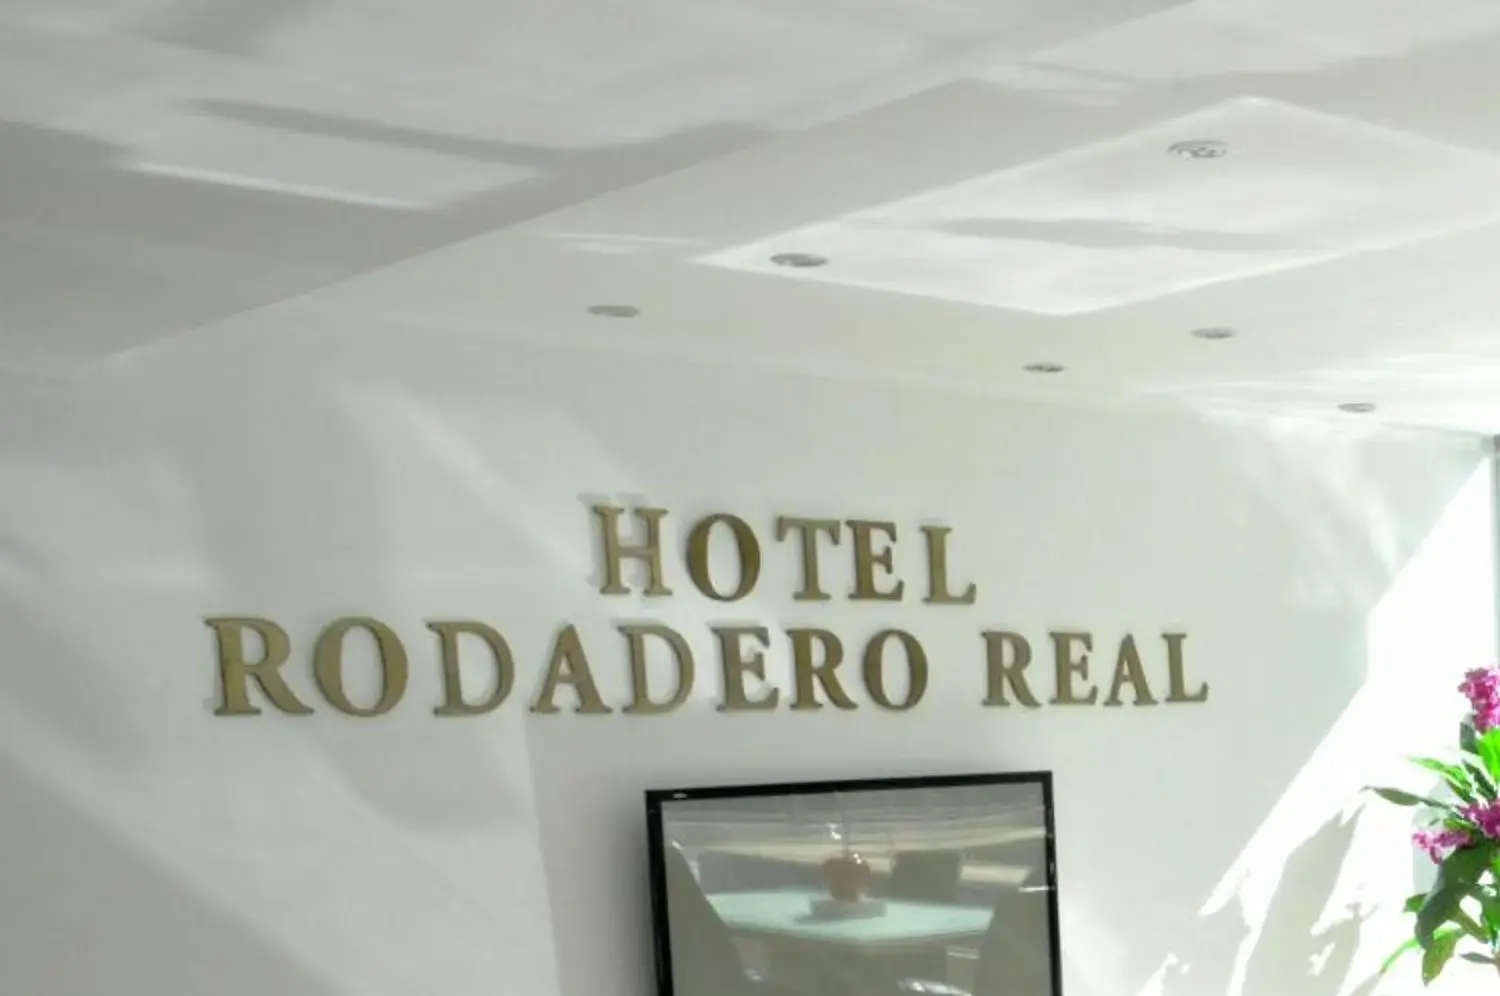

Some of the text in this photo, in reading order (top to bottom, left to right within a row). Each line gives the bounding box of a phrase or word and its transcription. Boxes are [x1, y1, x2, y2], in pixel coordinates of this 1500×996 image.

[593, 505, 977, 602] HOTEL
[206, 618, 1210, 715] RODADERO REAL
